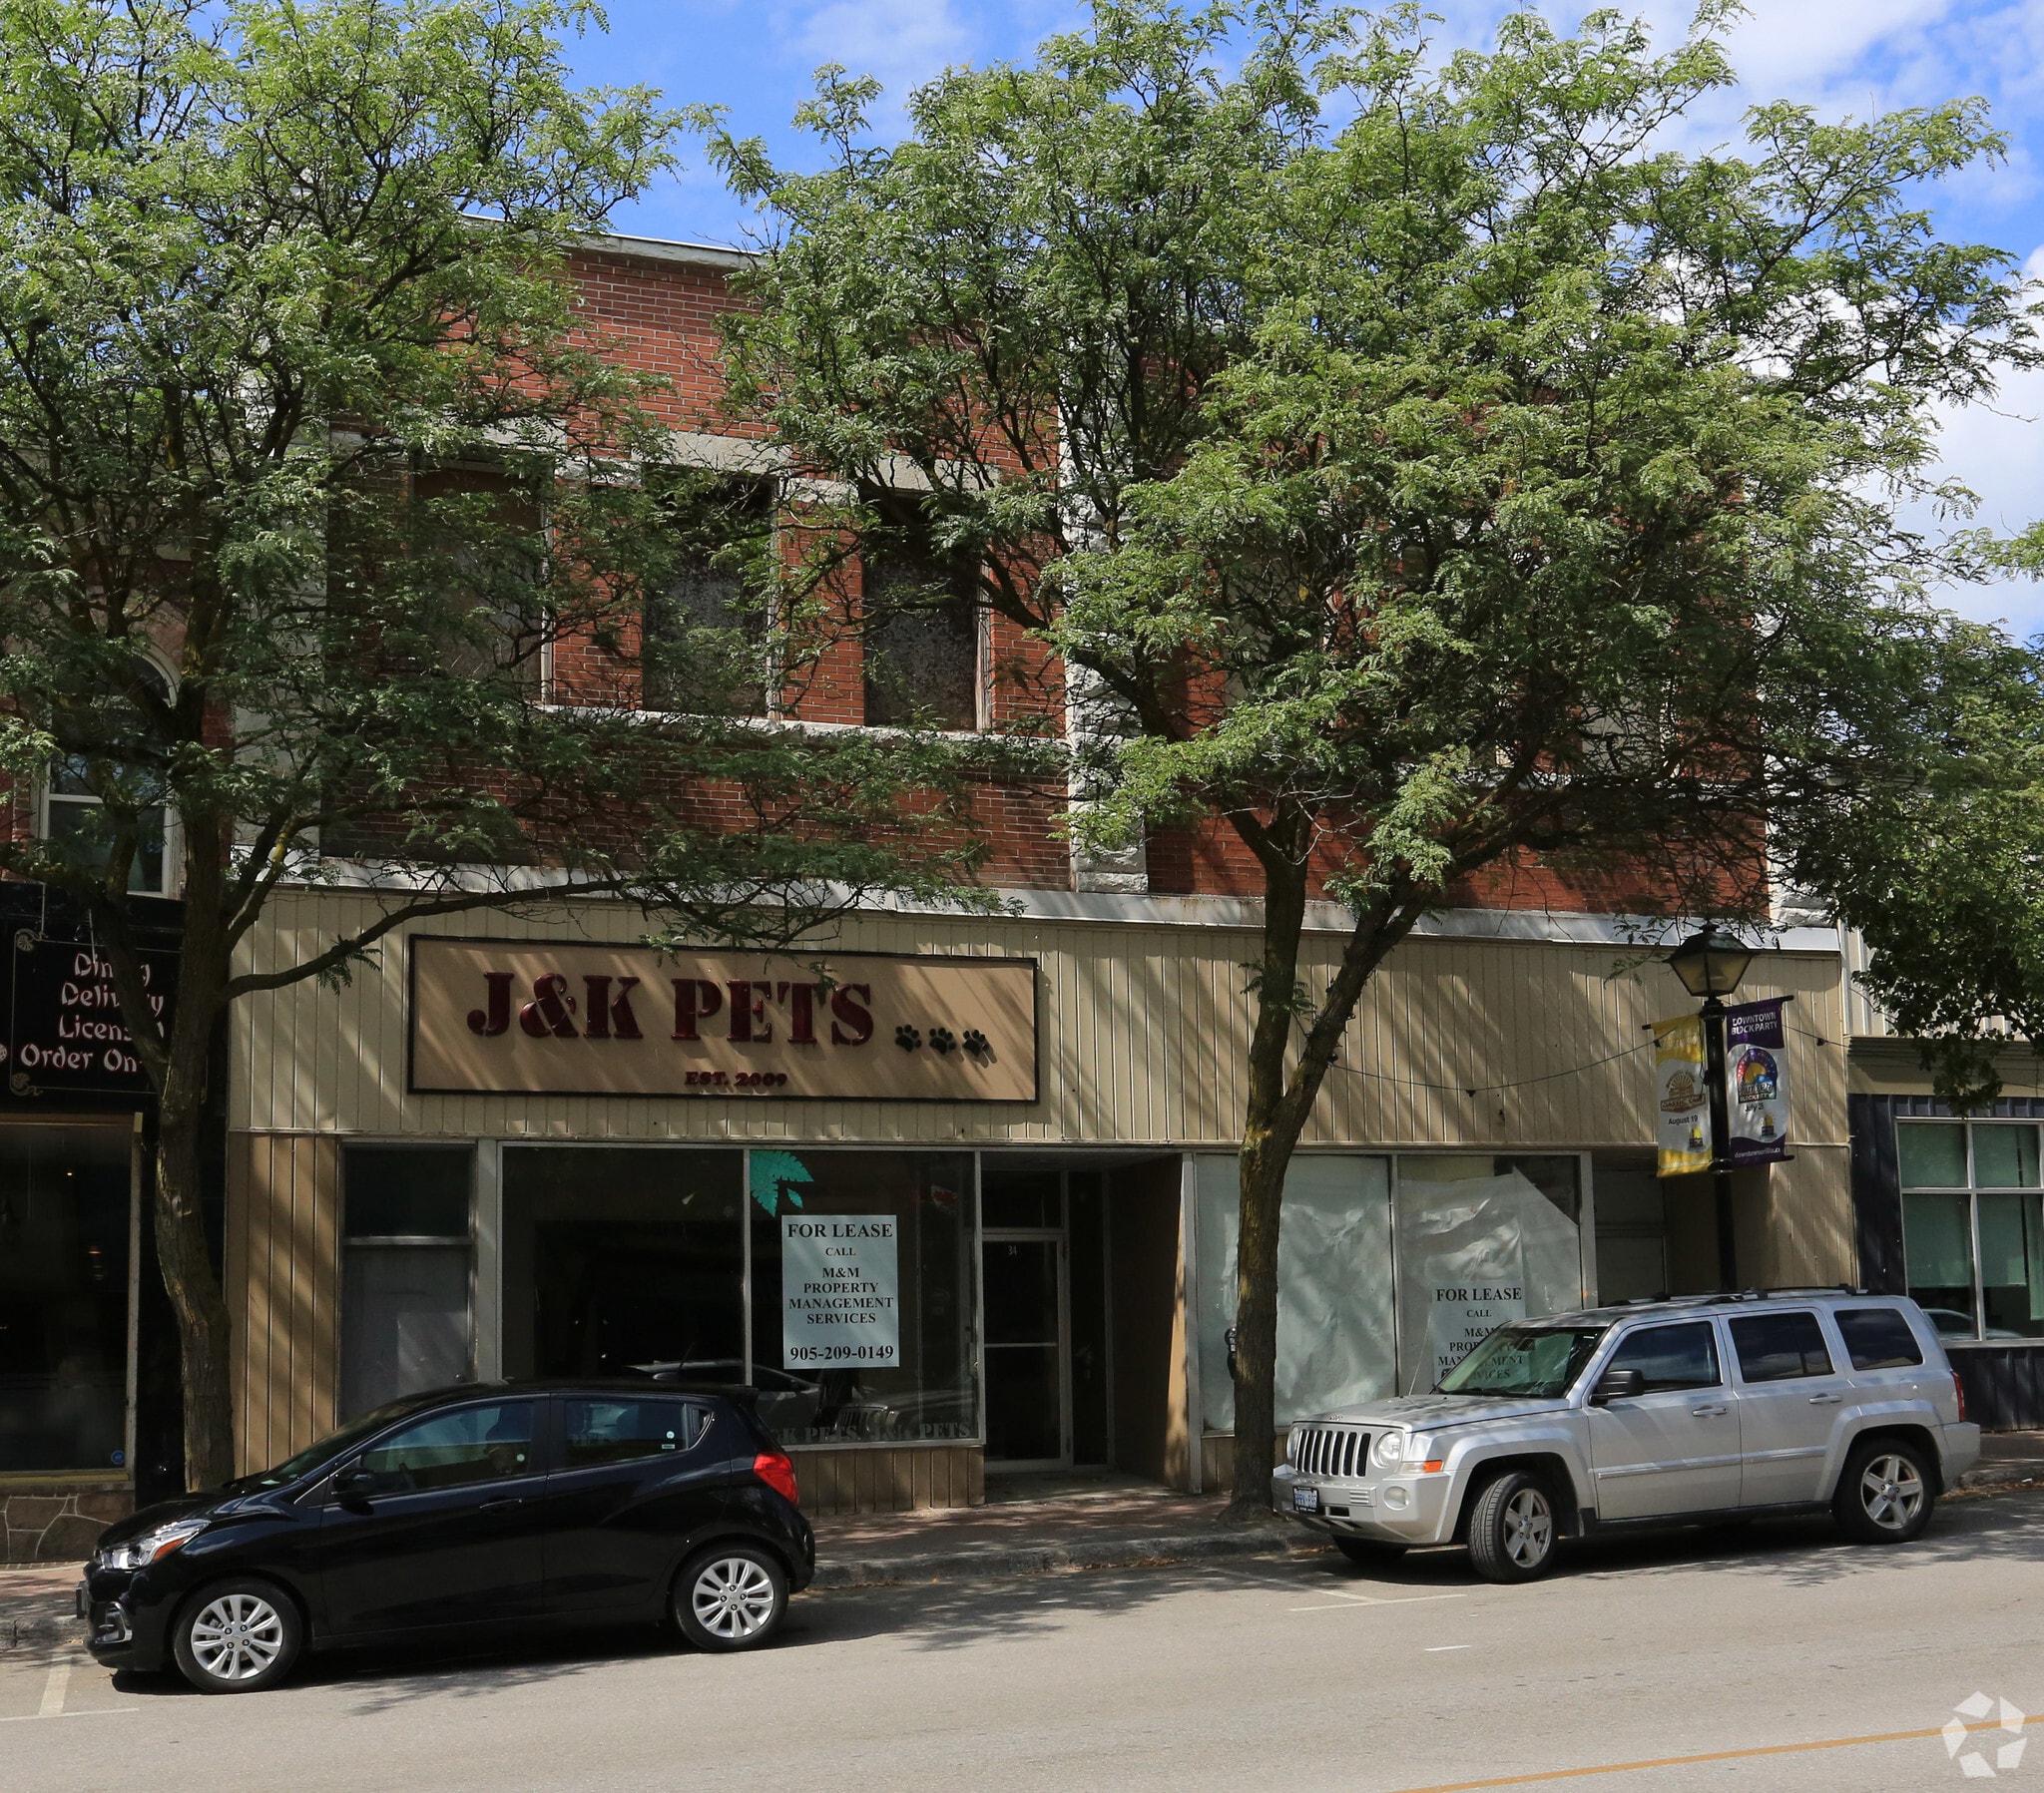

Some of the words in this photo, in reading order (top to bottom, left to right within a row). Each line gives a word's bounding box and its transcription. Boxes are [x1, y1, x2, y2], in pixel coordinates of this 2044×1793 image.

[466, 971, 644, 1040] J&K
[671, 978, 874, 1047] PETS
[1732, 1011, 1777, 1027] DOWNTOWN
[1755, 1021, 1778, 1032] PARTY
[20, 1044, 94, 1070] Order
[685, 1071, 729, 1086] EST.
[735, 1072, 787, 1088] 2009
[1669, 1117, 1690, 1126] August
[787, 1224, 827, 1238] FOR
[832, 1223, 893, 1238] LEASE
[825, 1247, 856, 1256] CALL
[822, 1267, 859, 1278] M&M
[803, 1282, 878, 1294] PROPERTY
[1436, 1288, 1468, 1301] FOR
[1472, 1287, 1522, 1301] LEASE
[788, 1296, 893, 1310] MANAGEMENT
[806, 1313, 876, 1325] SERVICES
[1466, 1309, 1492, 1318] CALL
[789, 1345, 894, 1361] 905-209-0149
[918, 1422, 972, 1440] PETS
